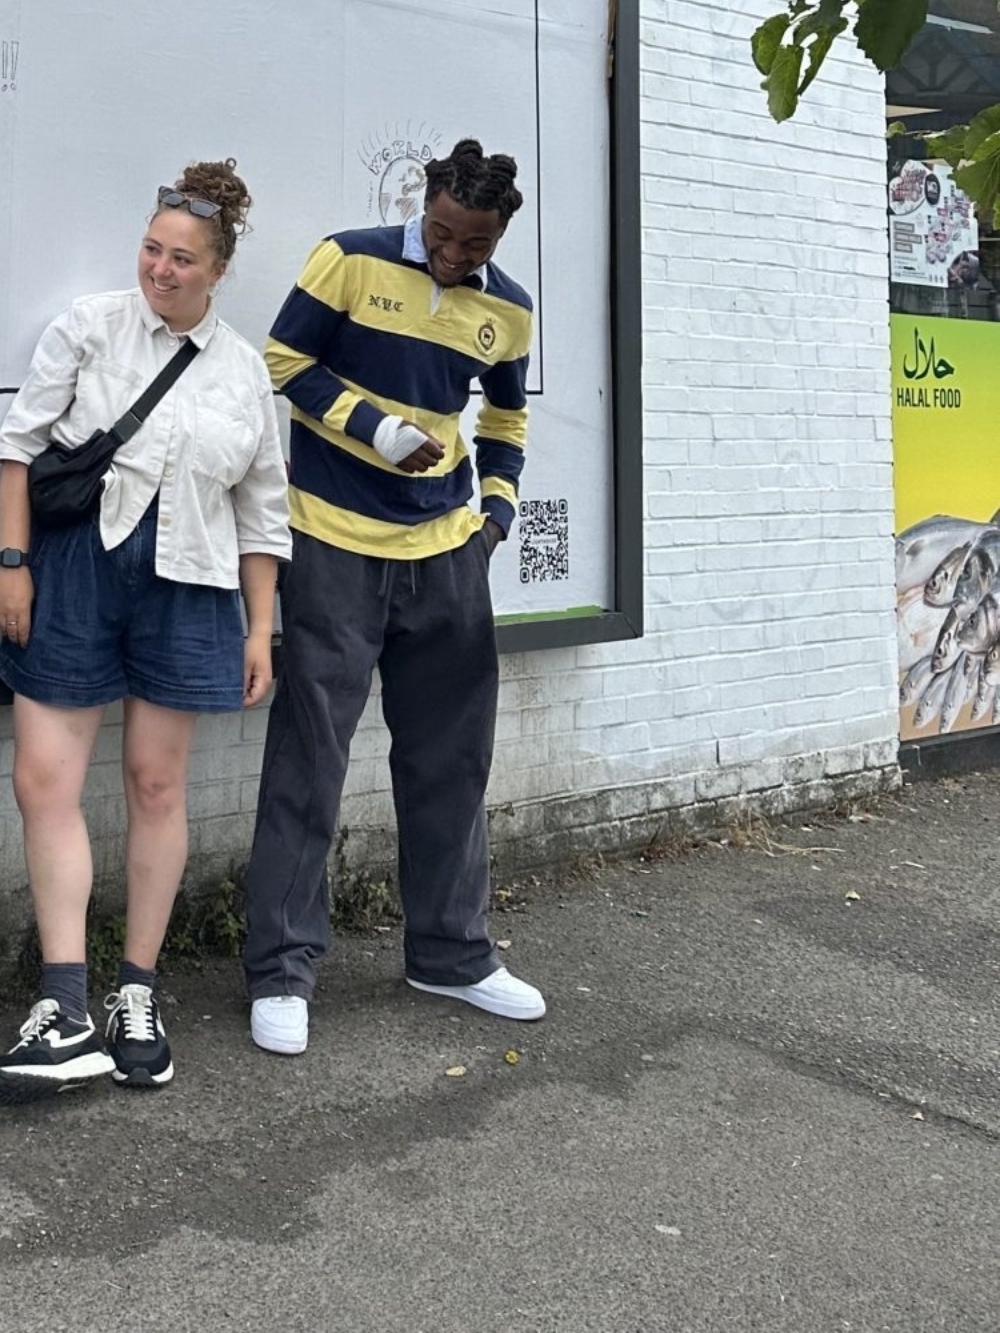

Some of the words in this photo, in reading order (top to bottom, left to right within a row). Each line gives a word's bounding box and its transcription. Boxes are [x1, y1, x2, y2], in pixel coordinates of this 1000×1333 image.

[367, 140, 433, 176] WORLD
[903, 326, 955, 381] حلال
[896, 387, 931, 408] HALAL
[933, 388, 962, 408] FOOD
